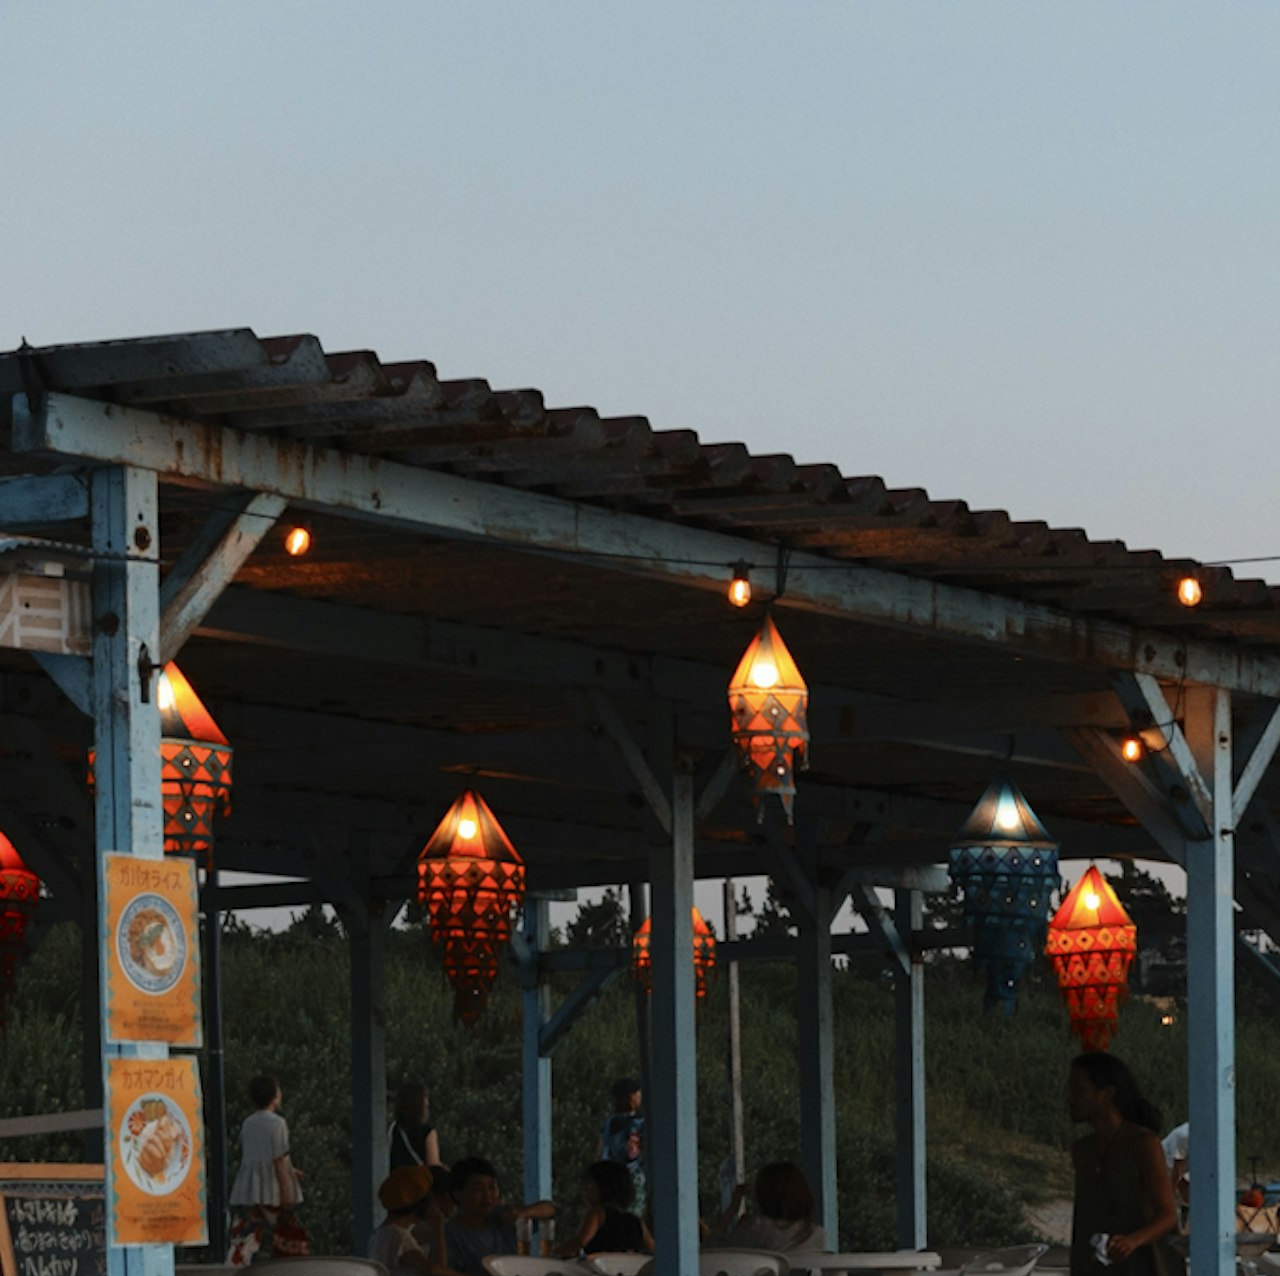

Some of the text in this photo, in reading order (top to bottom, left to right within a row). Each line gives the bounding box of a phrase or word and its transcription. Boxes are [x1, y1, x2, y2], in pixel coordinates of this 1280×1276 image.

[120, 865, 182, 890] ガパオライス
[122, 1067, 185, 1091] カオマンガイ
